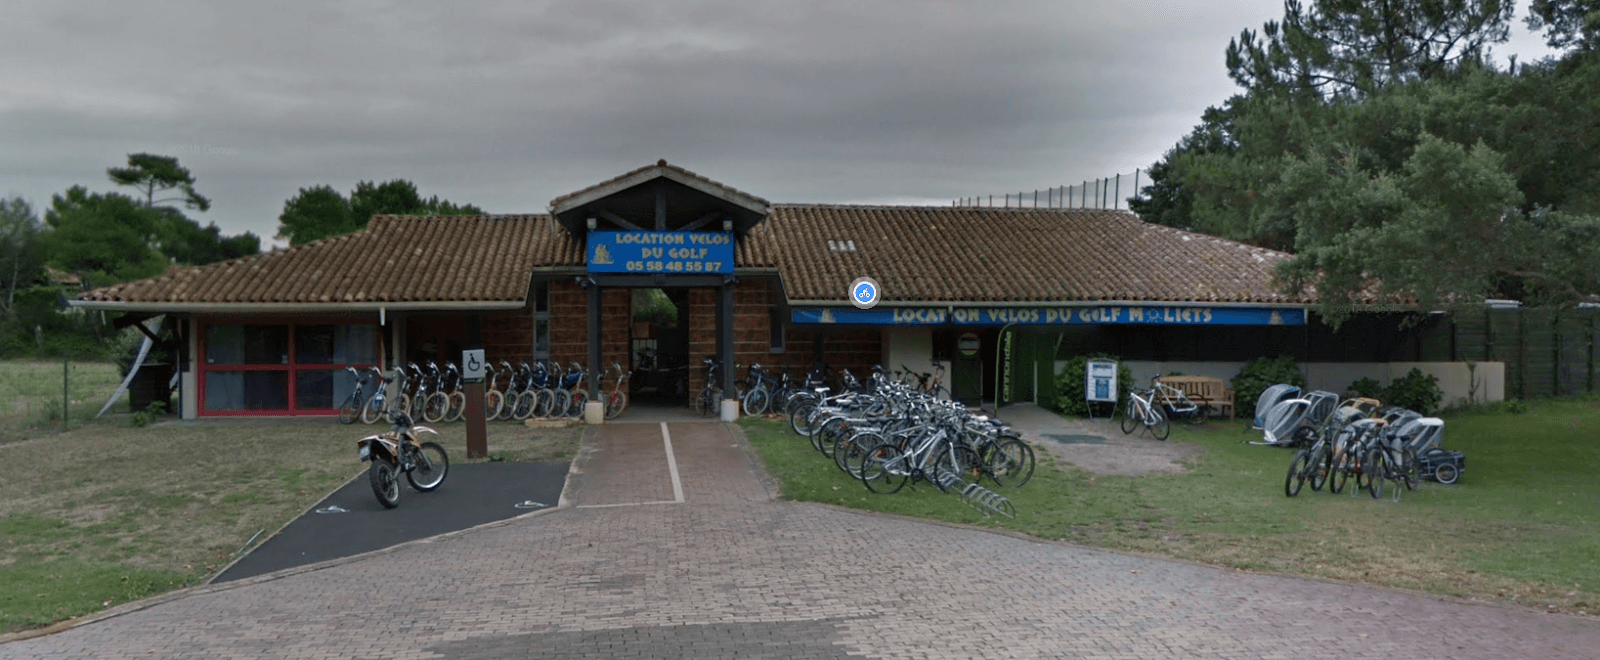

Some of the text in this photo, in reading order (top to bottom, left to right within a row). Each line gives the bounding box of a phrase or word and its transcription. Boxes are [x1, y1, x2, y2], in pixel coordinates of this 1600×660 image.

[615, 233, 730, 245] LOCATION VELOS
[641, 247, 709, 260] DU GOLF
[625, 260, 722, 272] 05 58 48 55 87
[893, 308, 981, 323] LOCATON
[987, 308, 1040, 323] VELOS
[1046, 308, 1072, 323] DU
[1078, 308, 1121, 323] GOLF
[1003, 331, 1012, 402] cannondale
